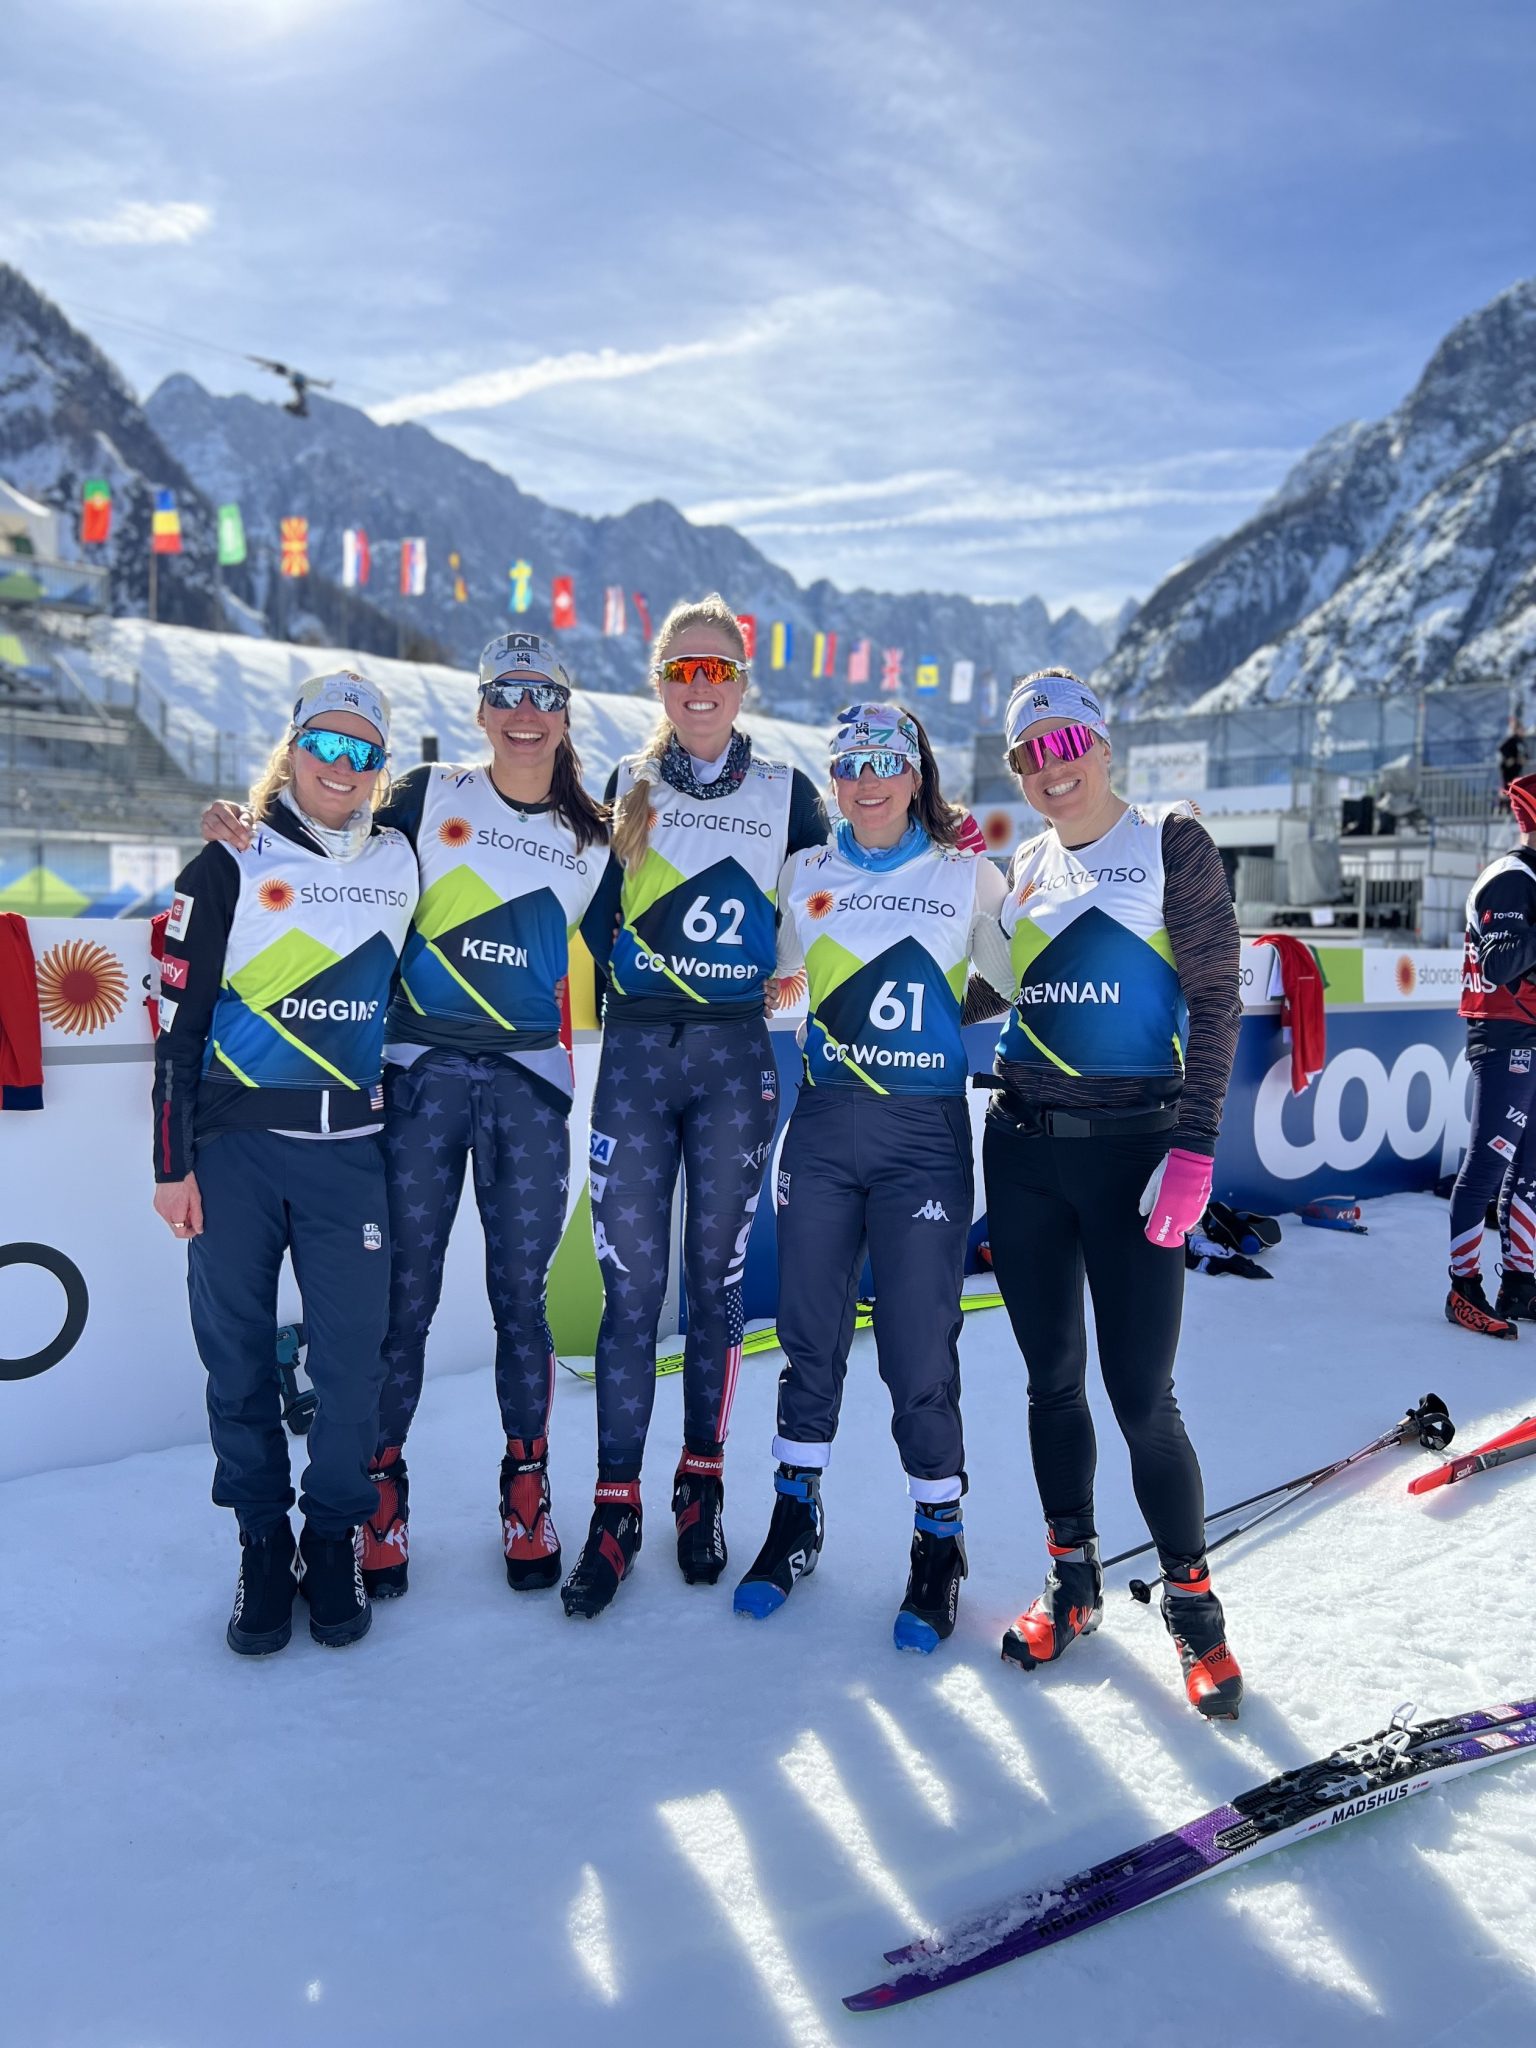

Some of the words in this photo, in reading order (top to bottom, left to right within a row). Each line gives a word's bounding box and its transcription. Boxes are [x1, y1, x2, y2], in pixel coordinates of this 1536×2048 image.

[1032, 694, 1047, 703] US
[855, 721, 870, 729] US
[661, 808, 772, 838] storaenso
[476, 827, 588, 876] storaenso
[300, 882, 408, 908] storaenso
[836, 892, 956, 918] storaenso
[682, 895, 746, 946] 62
[460, 937, 528, 968] KERN
[634, 951, 666, 973] CC
[671, 955, 759, 980] Women
[868, 980, 925, 1032] 61
[822, 1042, 850, 1062] CC
[851, 1043, 946, 1069] Women
[1511, 1049, 1530, 1058] US
[762, 1071, 776, 1081] US
[1505, 1104, 1528, 1129] VIS
[778, 1171, 791, 1184] US
[364, 1223, 379, 1234] US
[1330, 1783, 1409, 1826] MADSHUS
